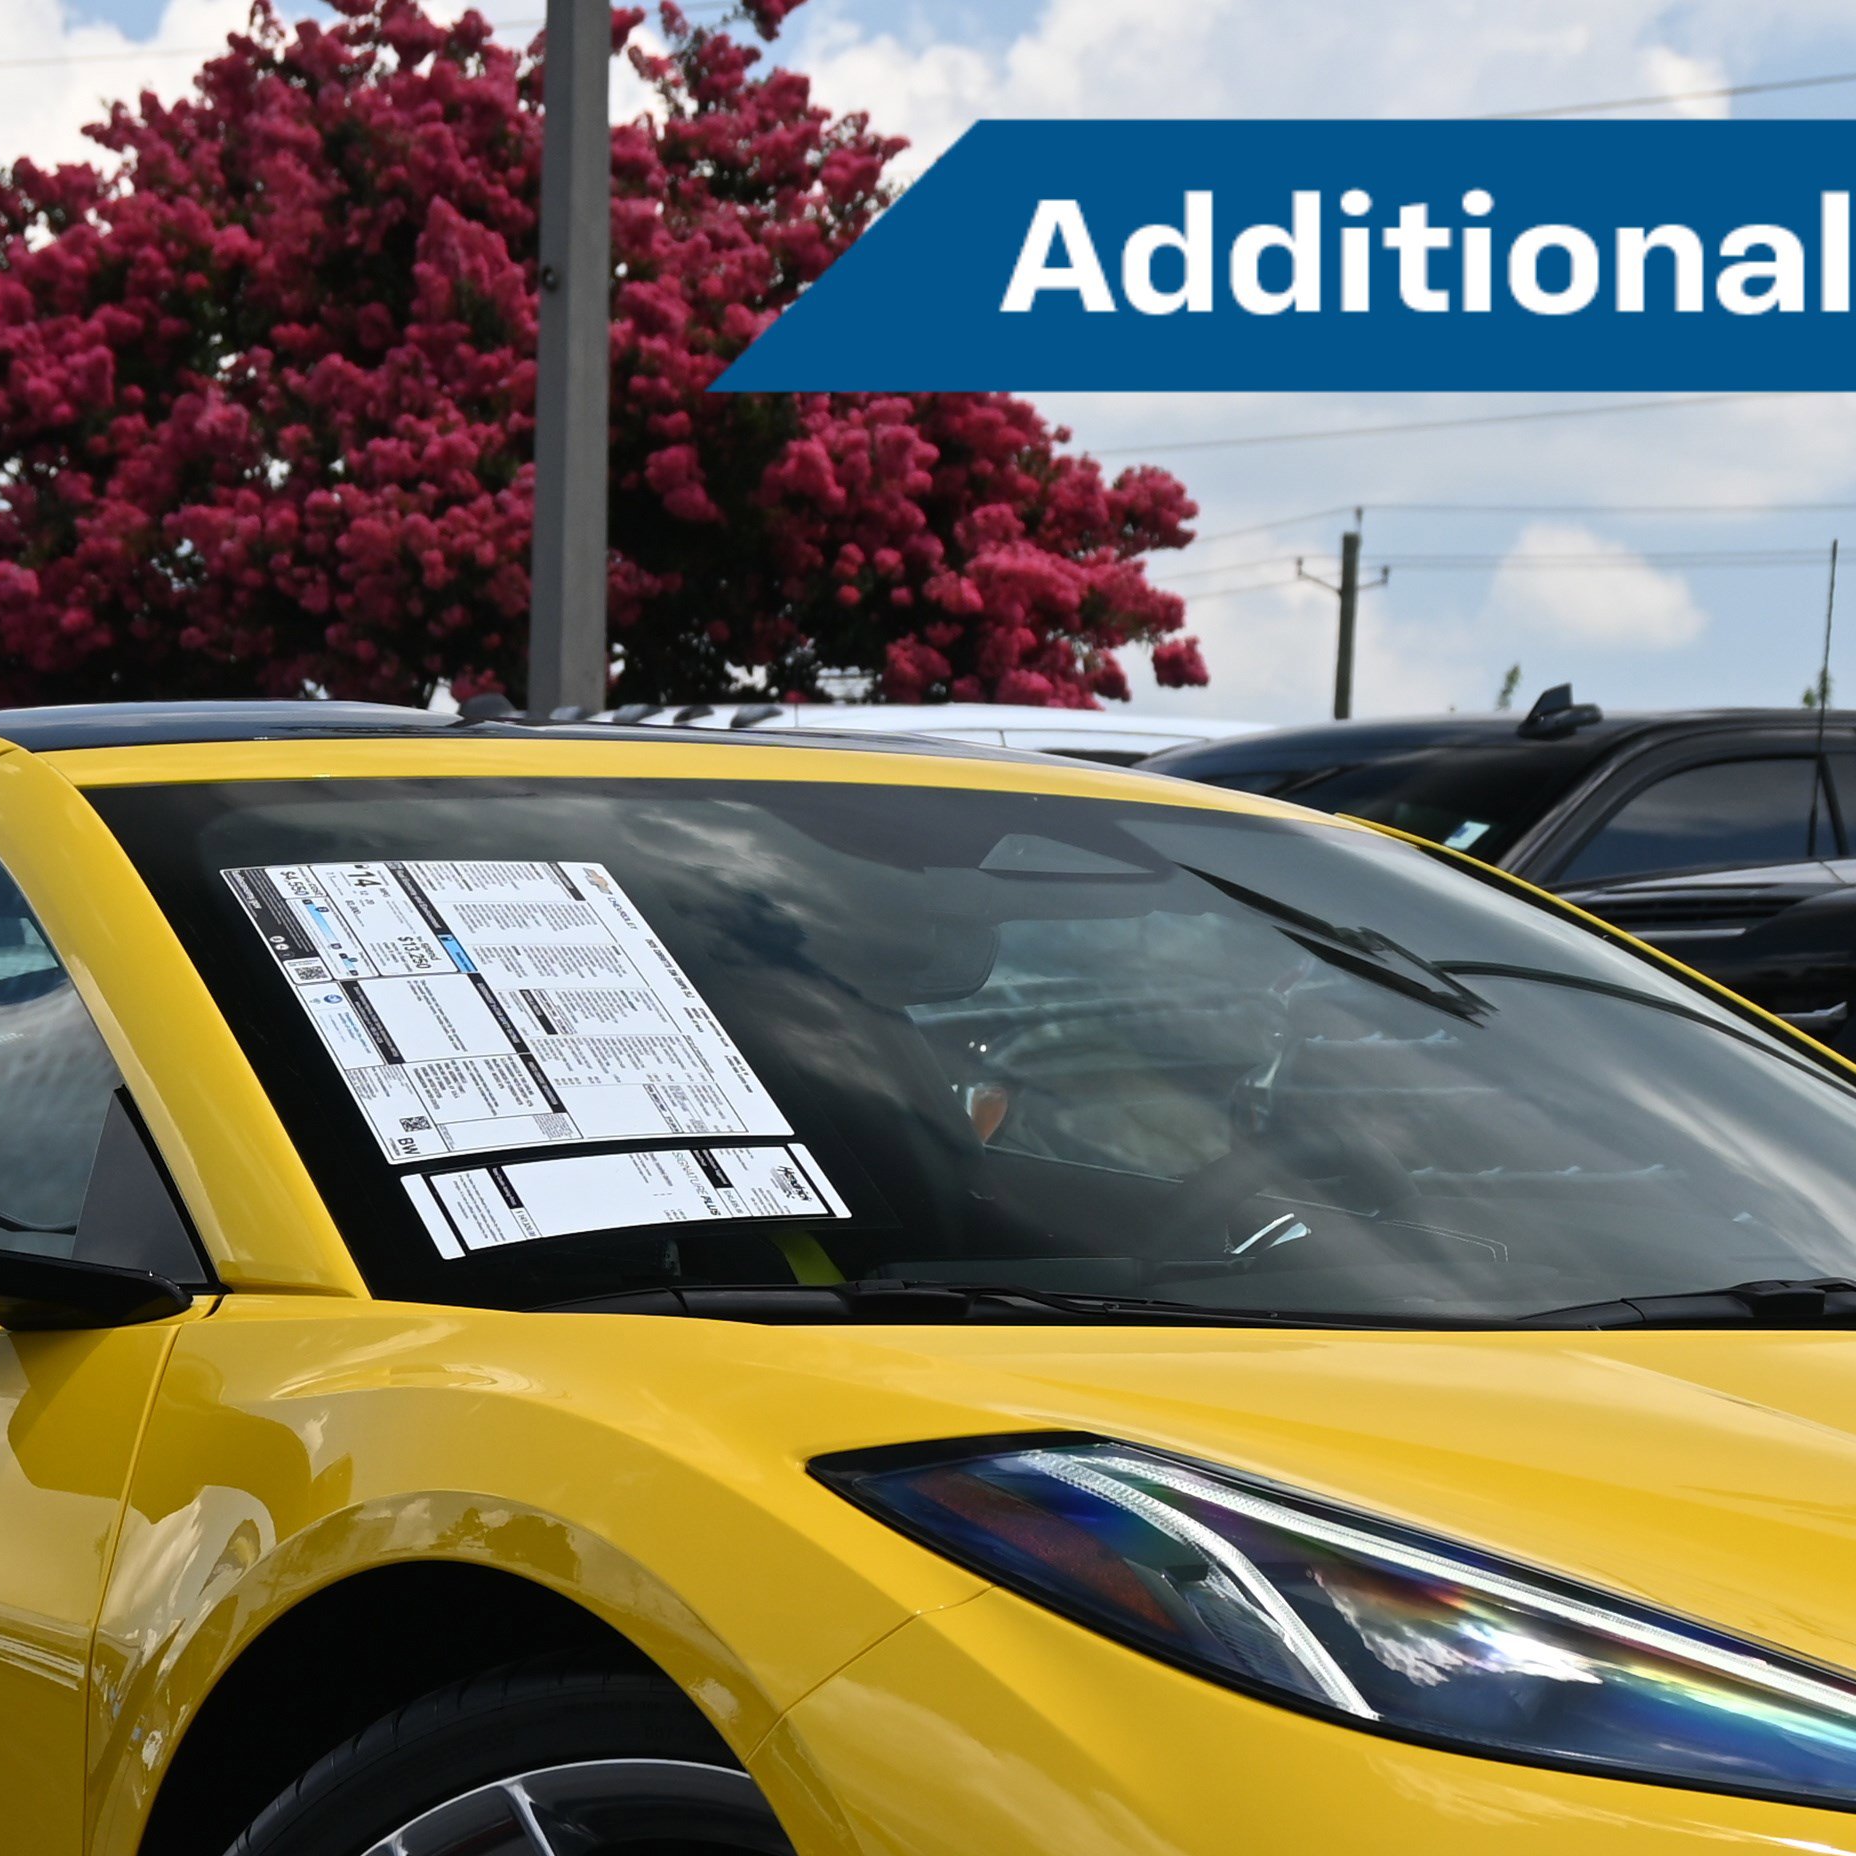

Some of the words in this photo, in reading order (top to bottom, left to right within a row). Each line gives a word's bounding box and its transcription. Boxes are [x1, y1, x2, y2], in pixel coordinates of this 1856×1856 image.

[278, 870, 310, 895] $4,550
[344, 870, 383, 887] 14
[397, 1137, 421, 1154] BW
[700, 1195, 722, 1216] PLUS
